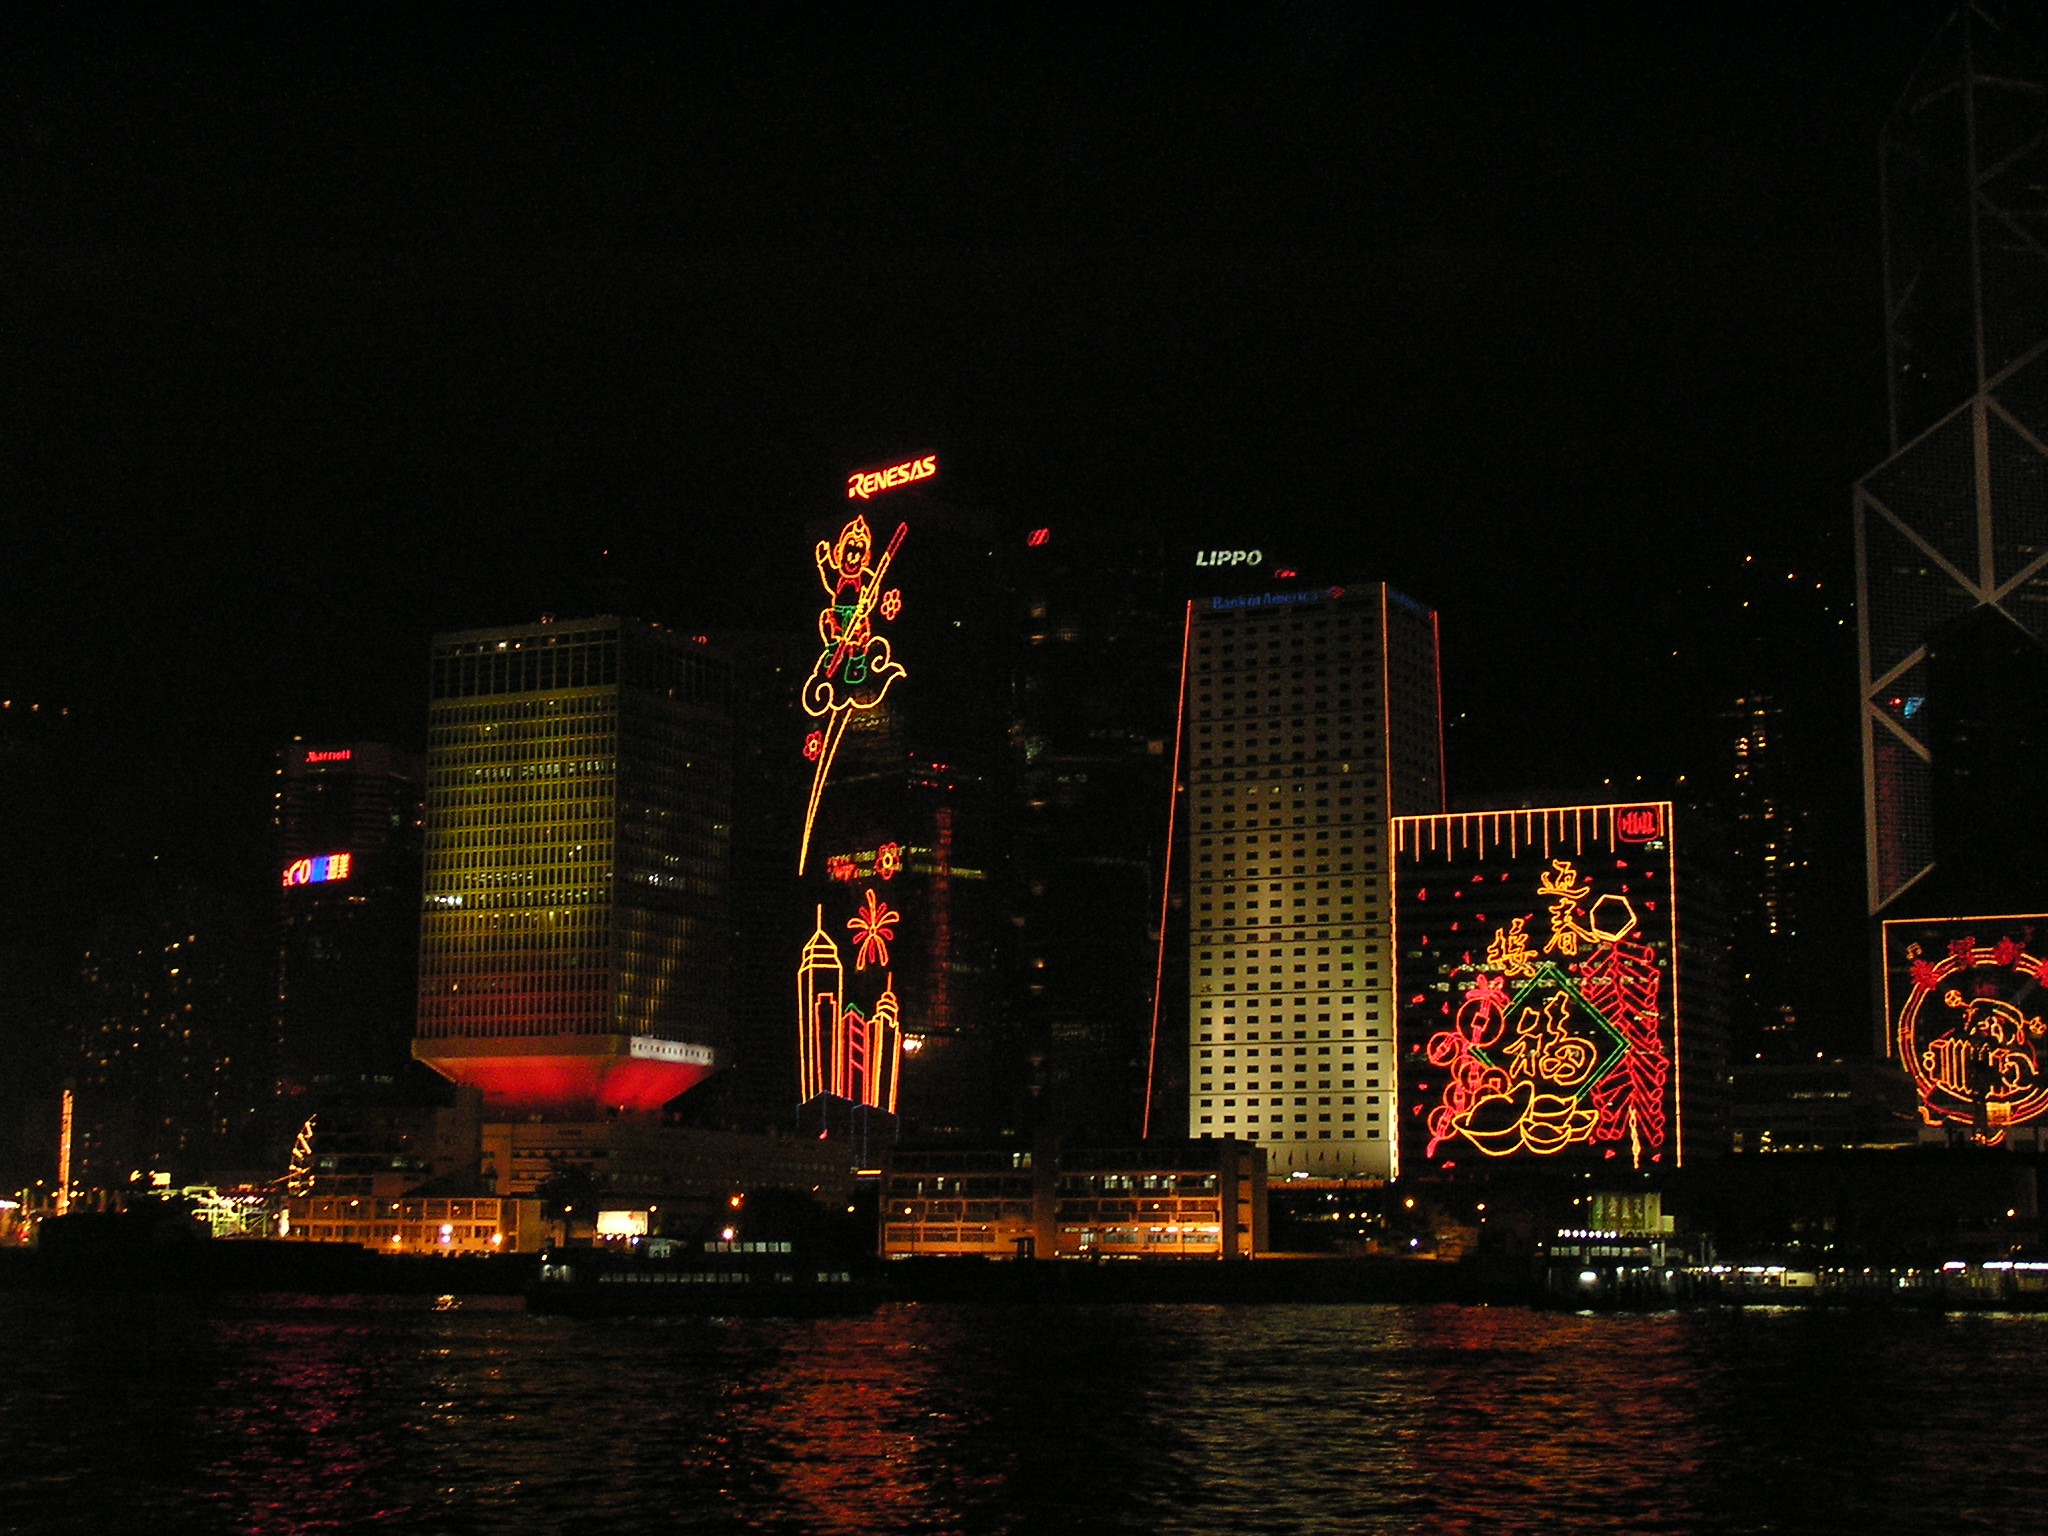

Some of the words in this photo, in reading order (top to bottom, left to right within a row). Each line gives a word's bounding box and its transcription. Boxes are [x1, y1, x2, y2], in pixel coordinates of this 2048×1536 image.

[848, 455, 936, 499] RENESAS
[1195, 550, 1263, 566] LIPPO
[305, 749, 351, 763] Marriott
